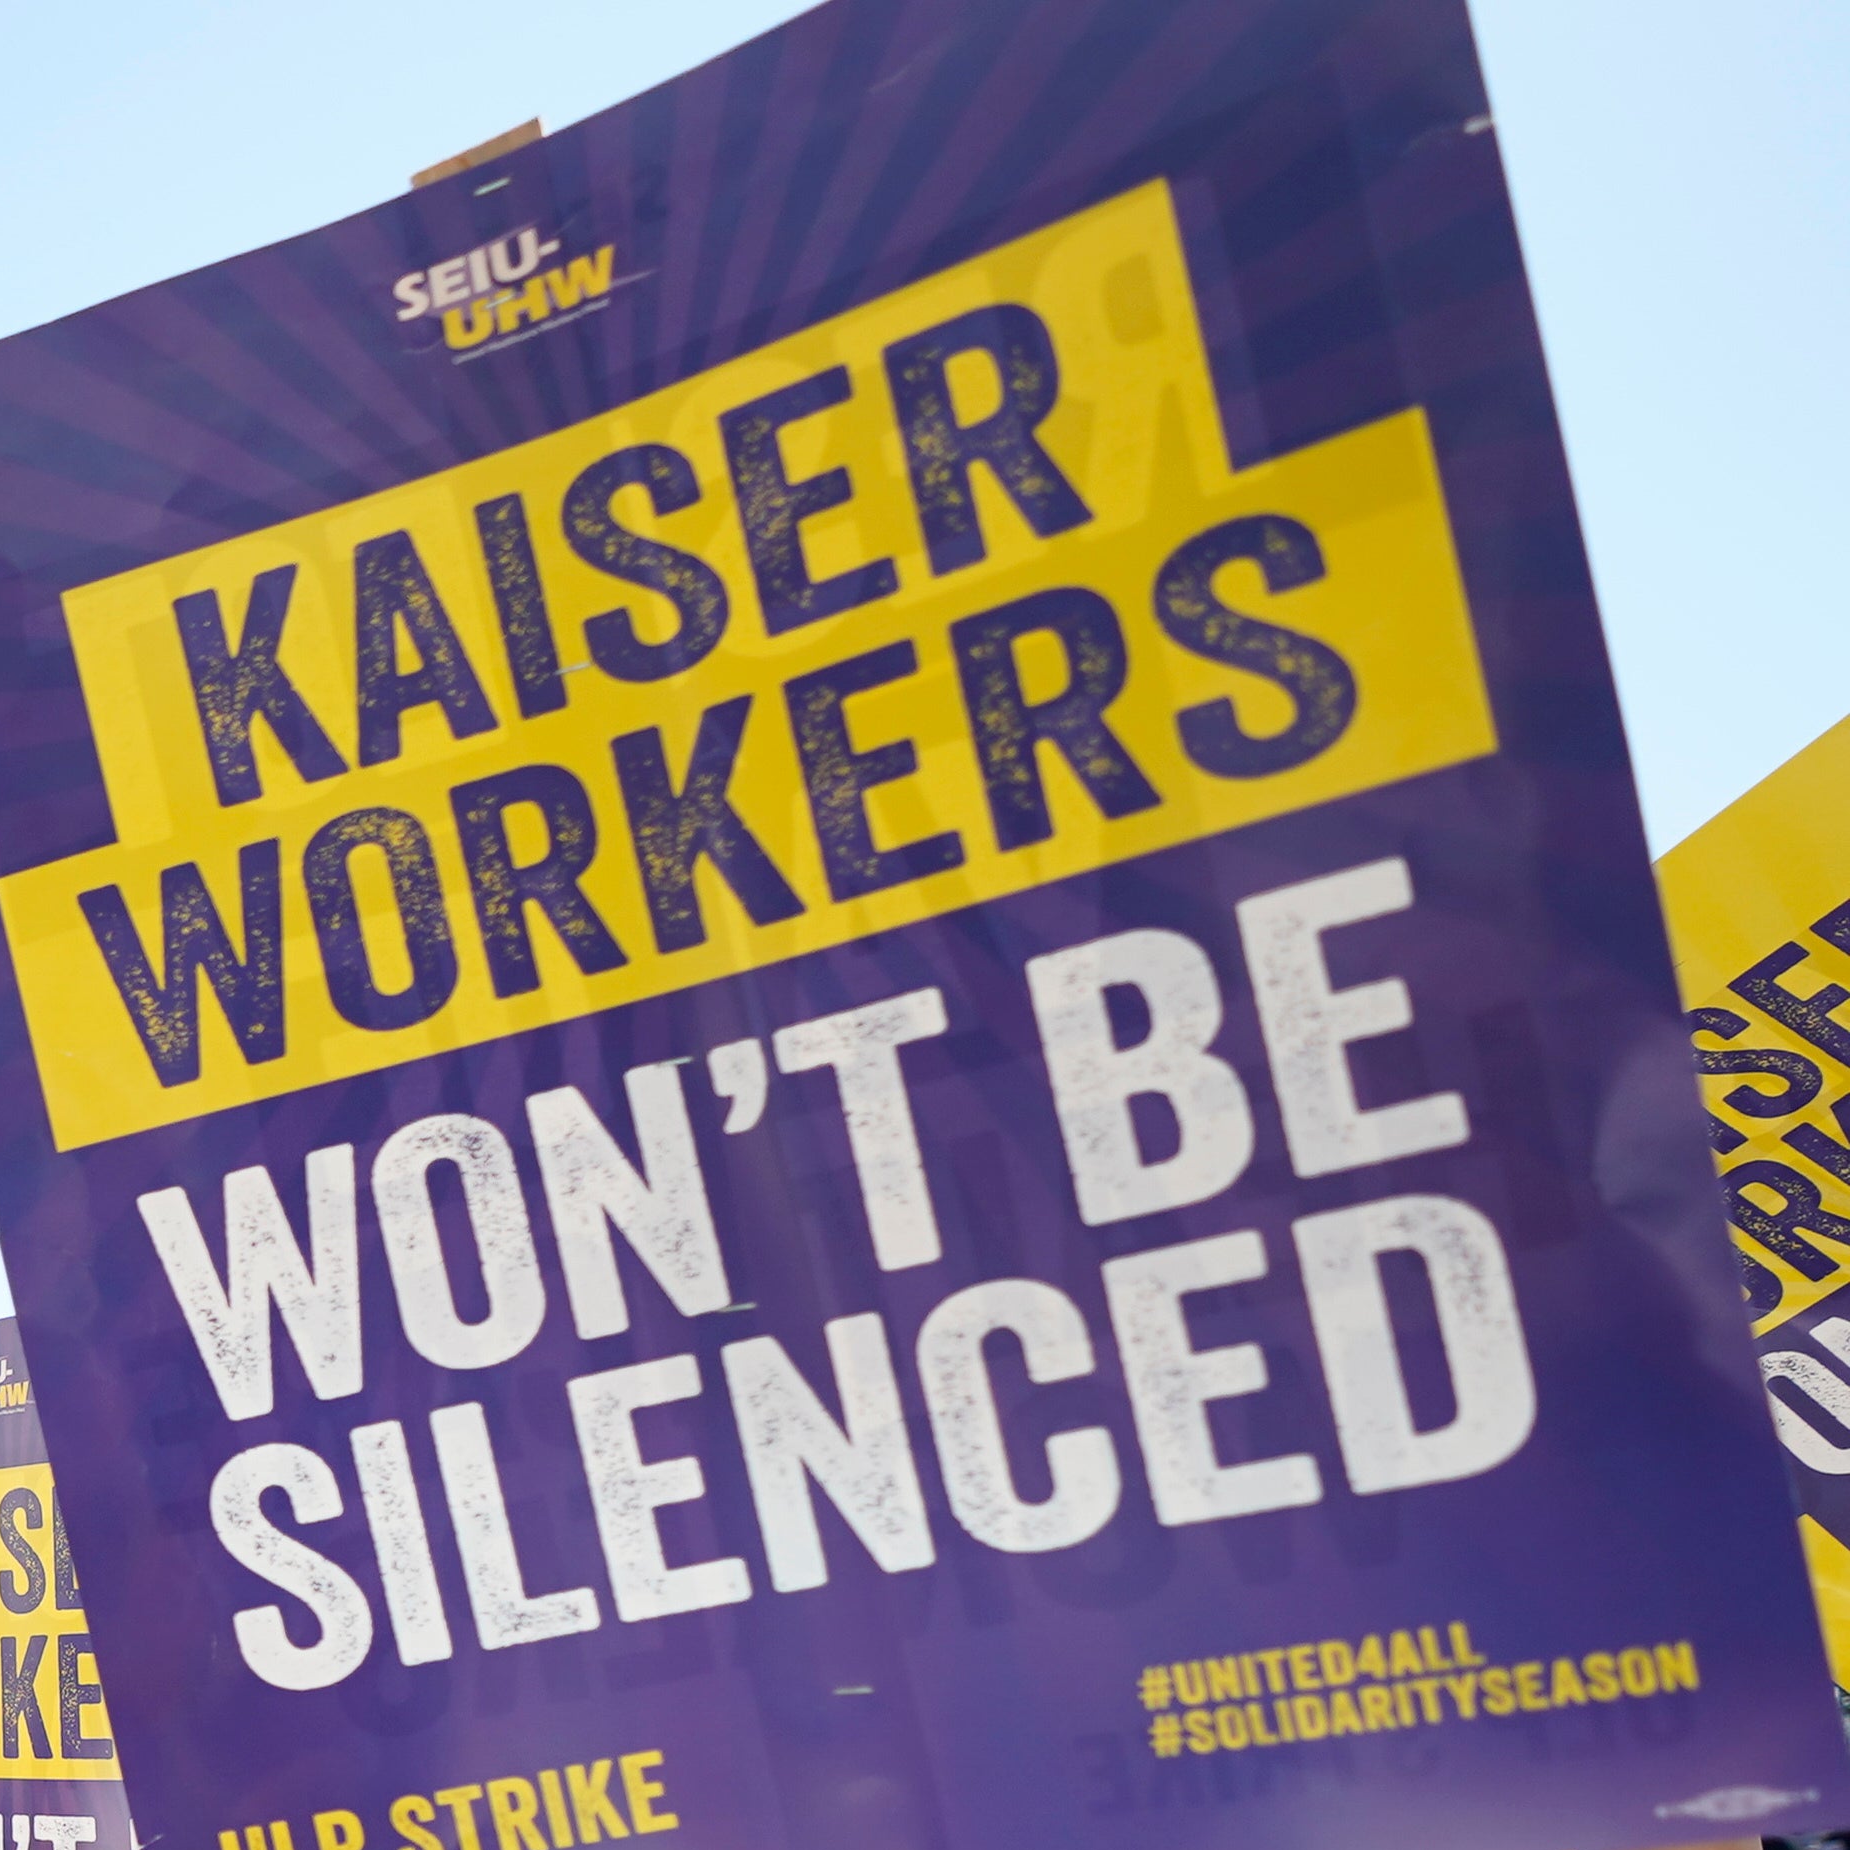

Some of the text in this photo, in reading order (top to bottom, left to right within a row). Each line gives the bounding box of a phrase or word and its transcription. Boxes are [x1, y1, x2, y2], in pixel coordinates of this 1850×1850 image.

[393, 228, 561, 322] SEIU-
[441, 244, 616, 350] UHW
[171, 300, 1095, 806] KAISER
[76, 513, 1361, 1090] WORKERS
[135, 857, 1469, 1421] WON'T BE
[208, 1190, 1539, 1692] SILENCED
[1137, 1621, 1487, 1711] #UNITED4ALL
[1147, 1640, 1700, 1758] #SOLIDARITYSEASON
